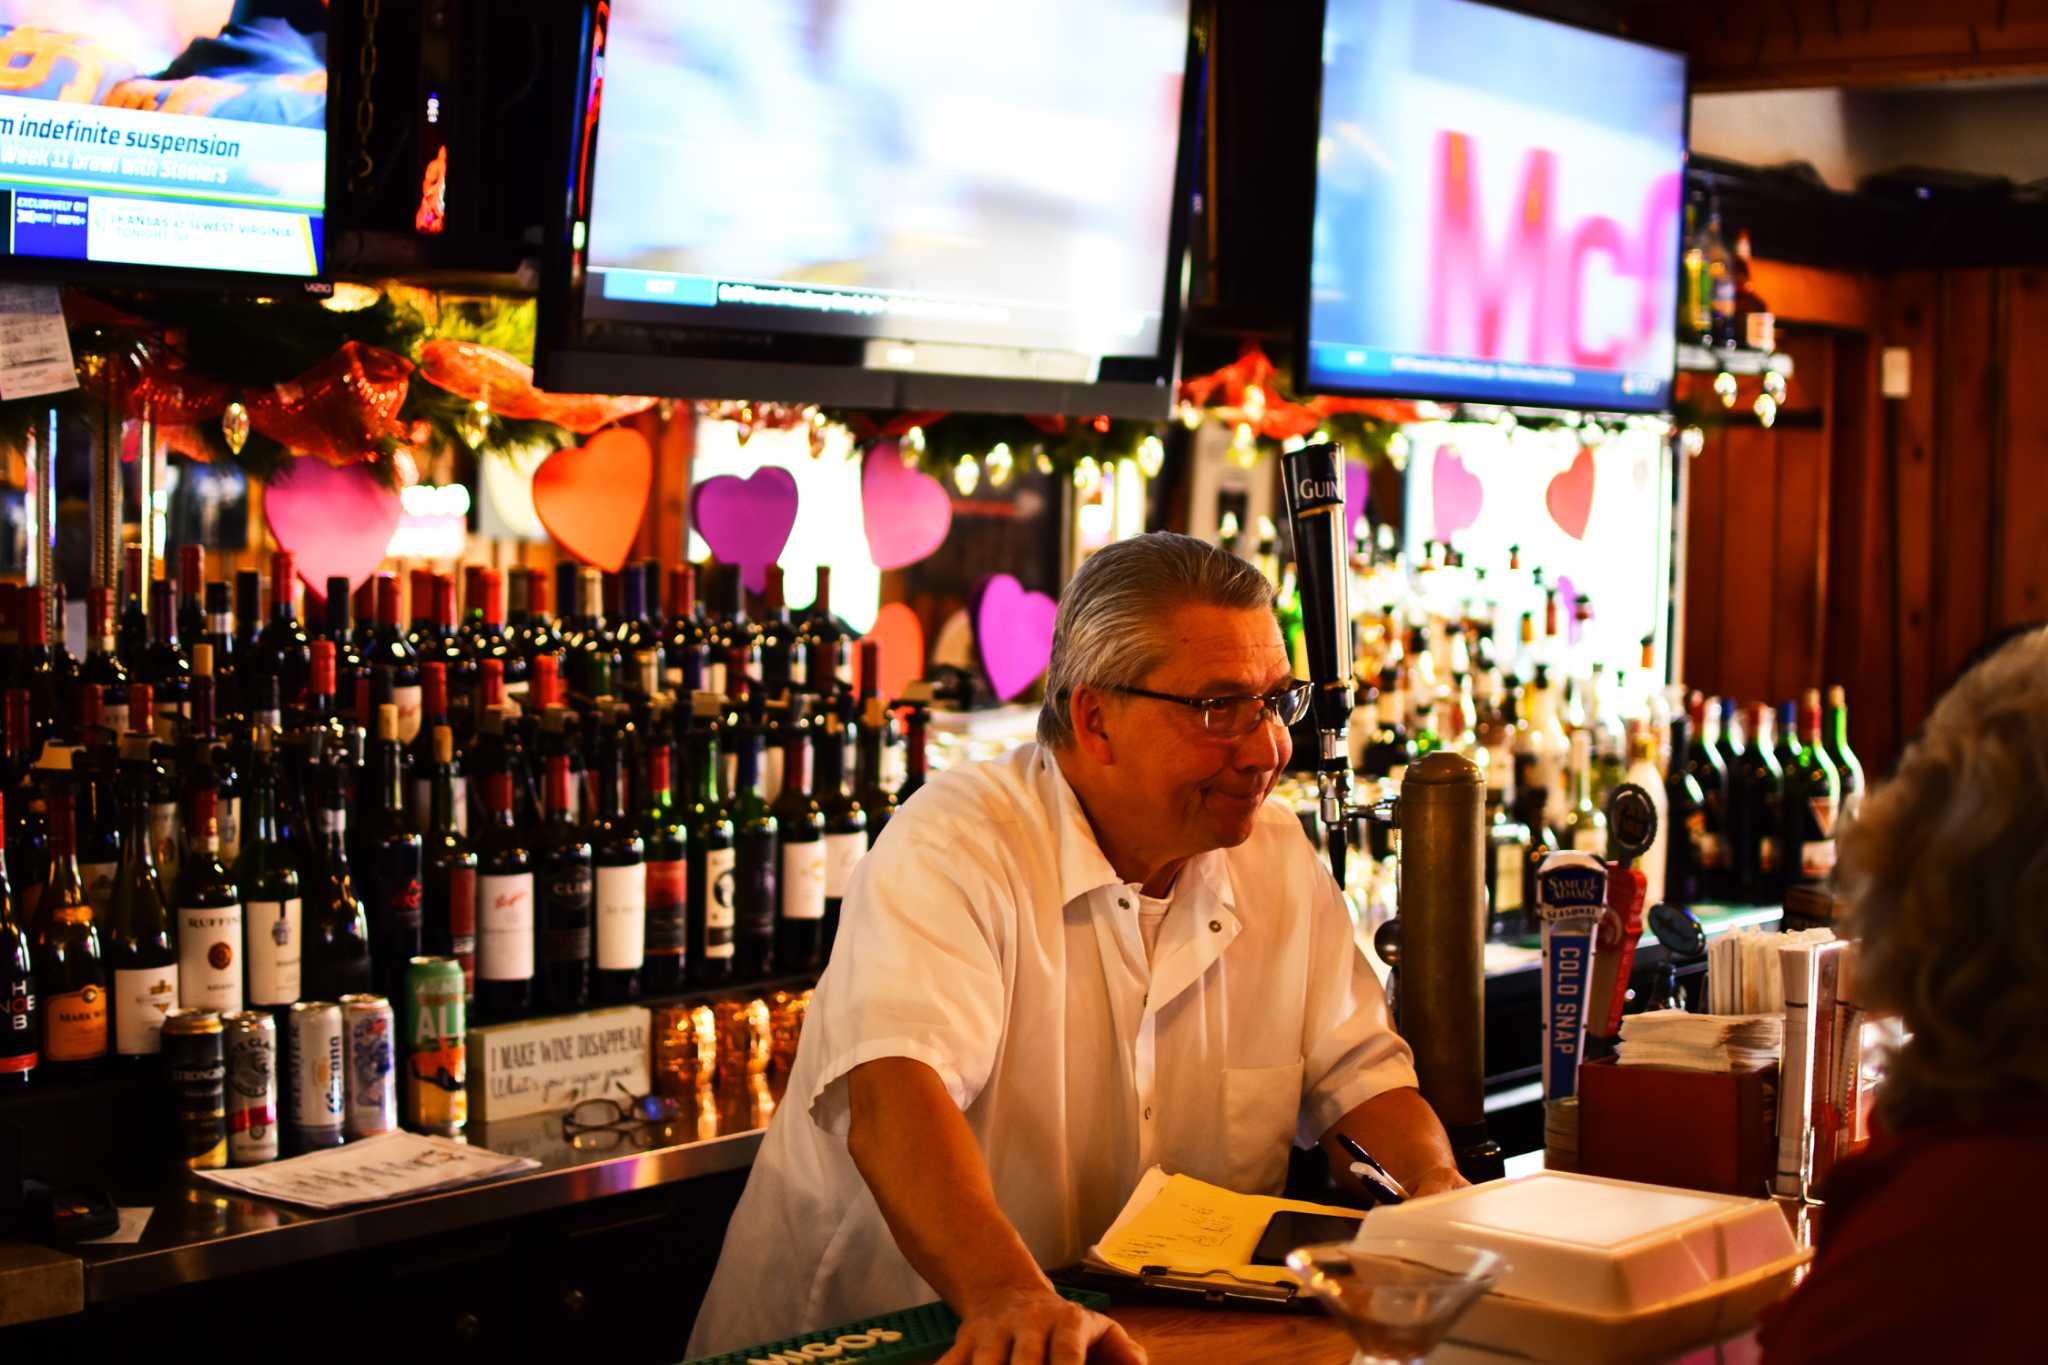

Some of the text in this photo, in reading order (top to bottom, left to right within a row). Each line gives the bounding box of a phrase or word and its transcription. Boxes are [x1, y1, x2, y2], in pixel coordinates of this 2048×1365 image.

[19, 114, 121, 146] indefinite
[125, 130, 241, 158] suspension
[1548, 877, 1599, 891] SAMUEL
[1553, 887, 1595, 900] ADAMS
[1553, 947, 1581, 1055] COLD SNAP
